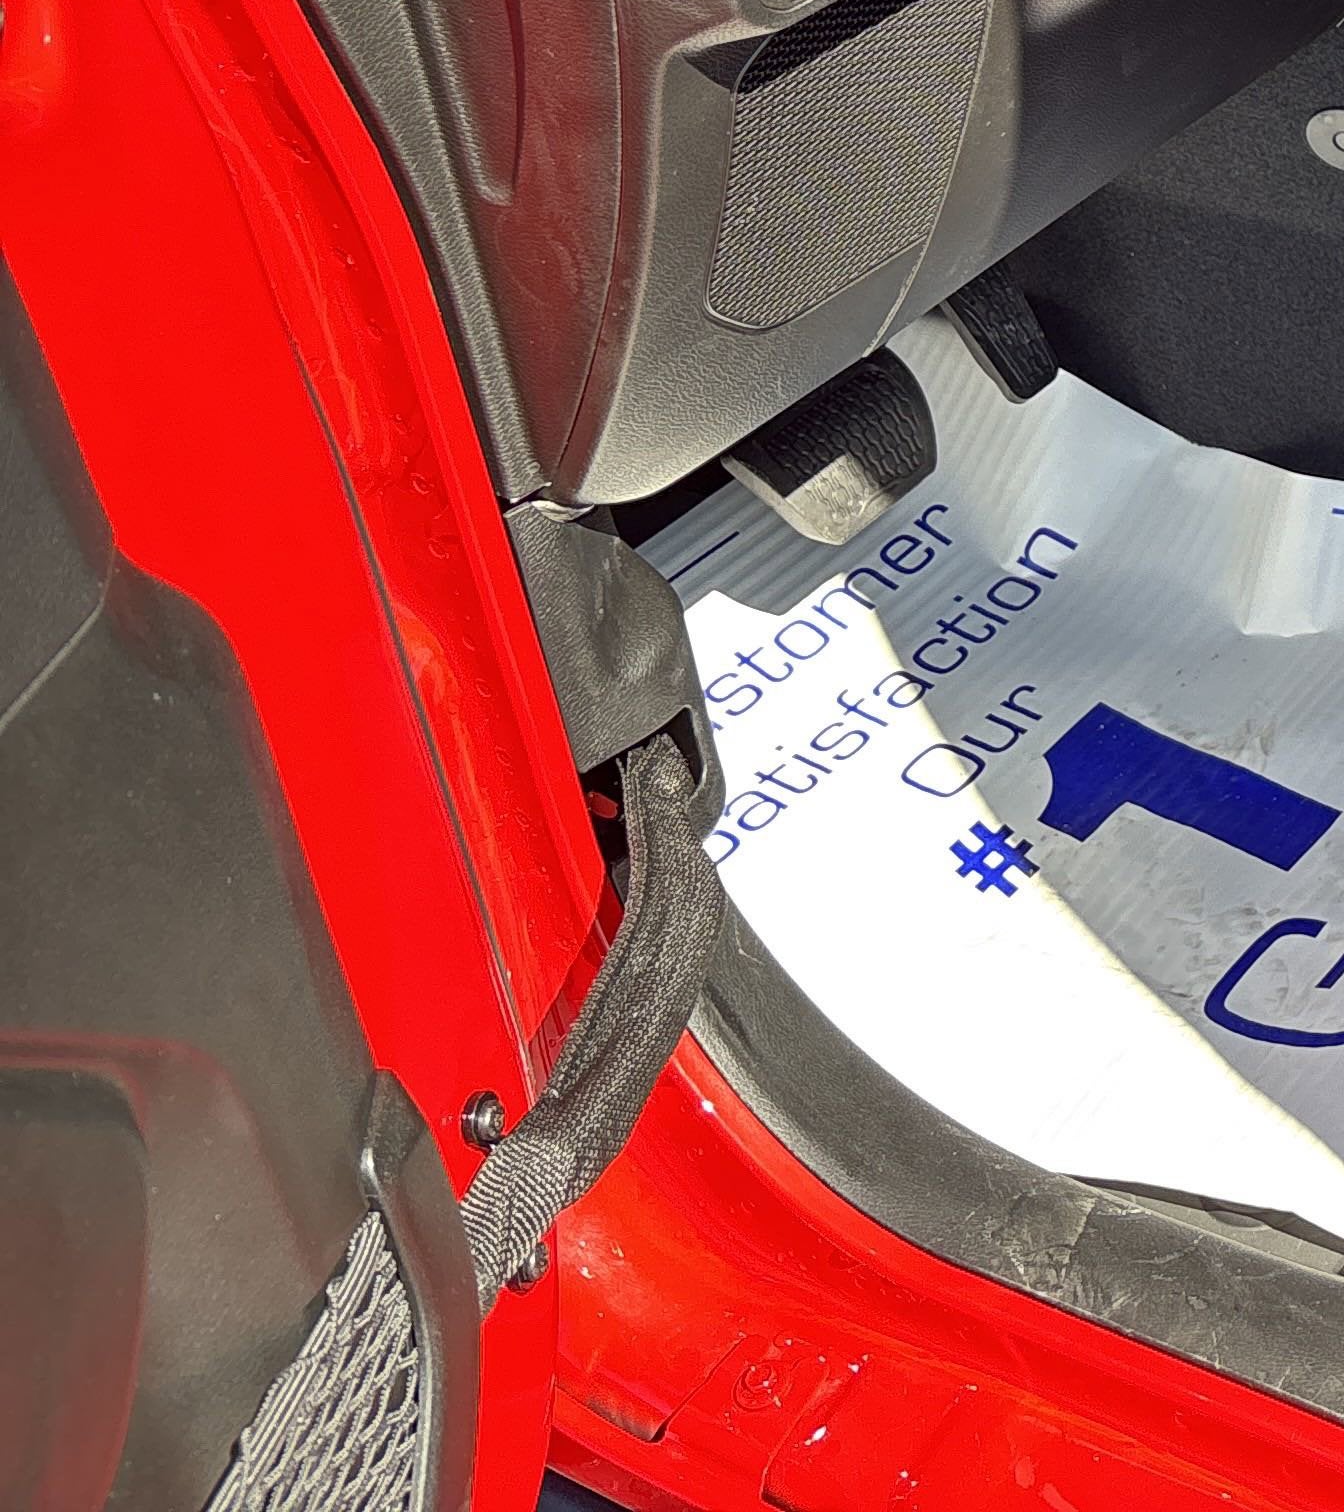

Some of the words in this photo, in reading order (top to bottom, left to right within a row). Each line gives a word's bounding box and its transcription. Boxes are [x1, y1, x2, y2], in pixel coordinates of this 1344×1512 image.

[703, 502, 953, 732] stomer
[901, 684, 1043, 799] Our
[948, 701, 1343, 898] #1
